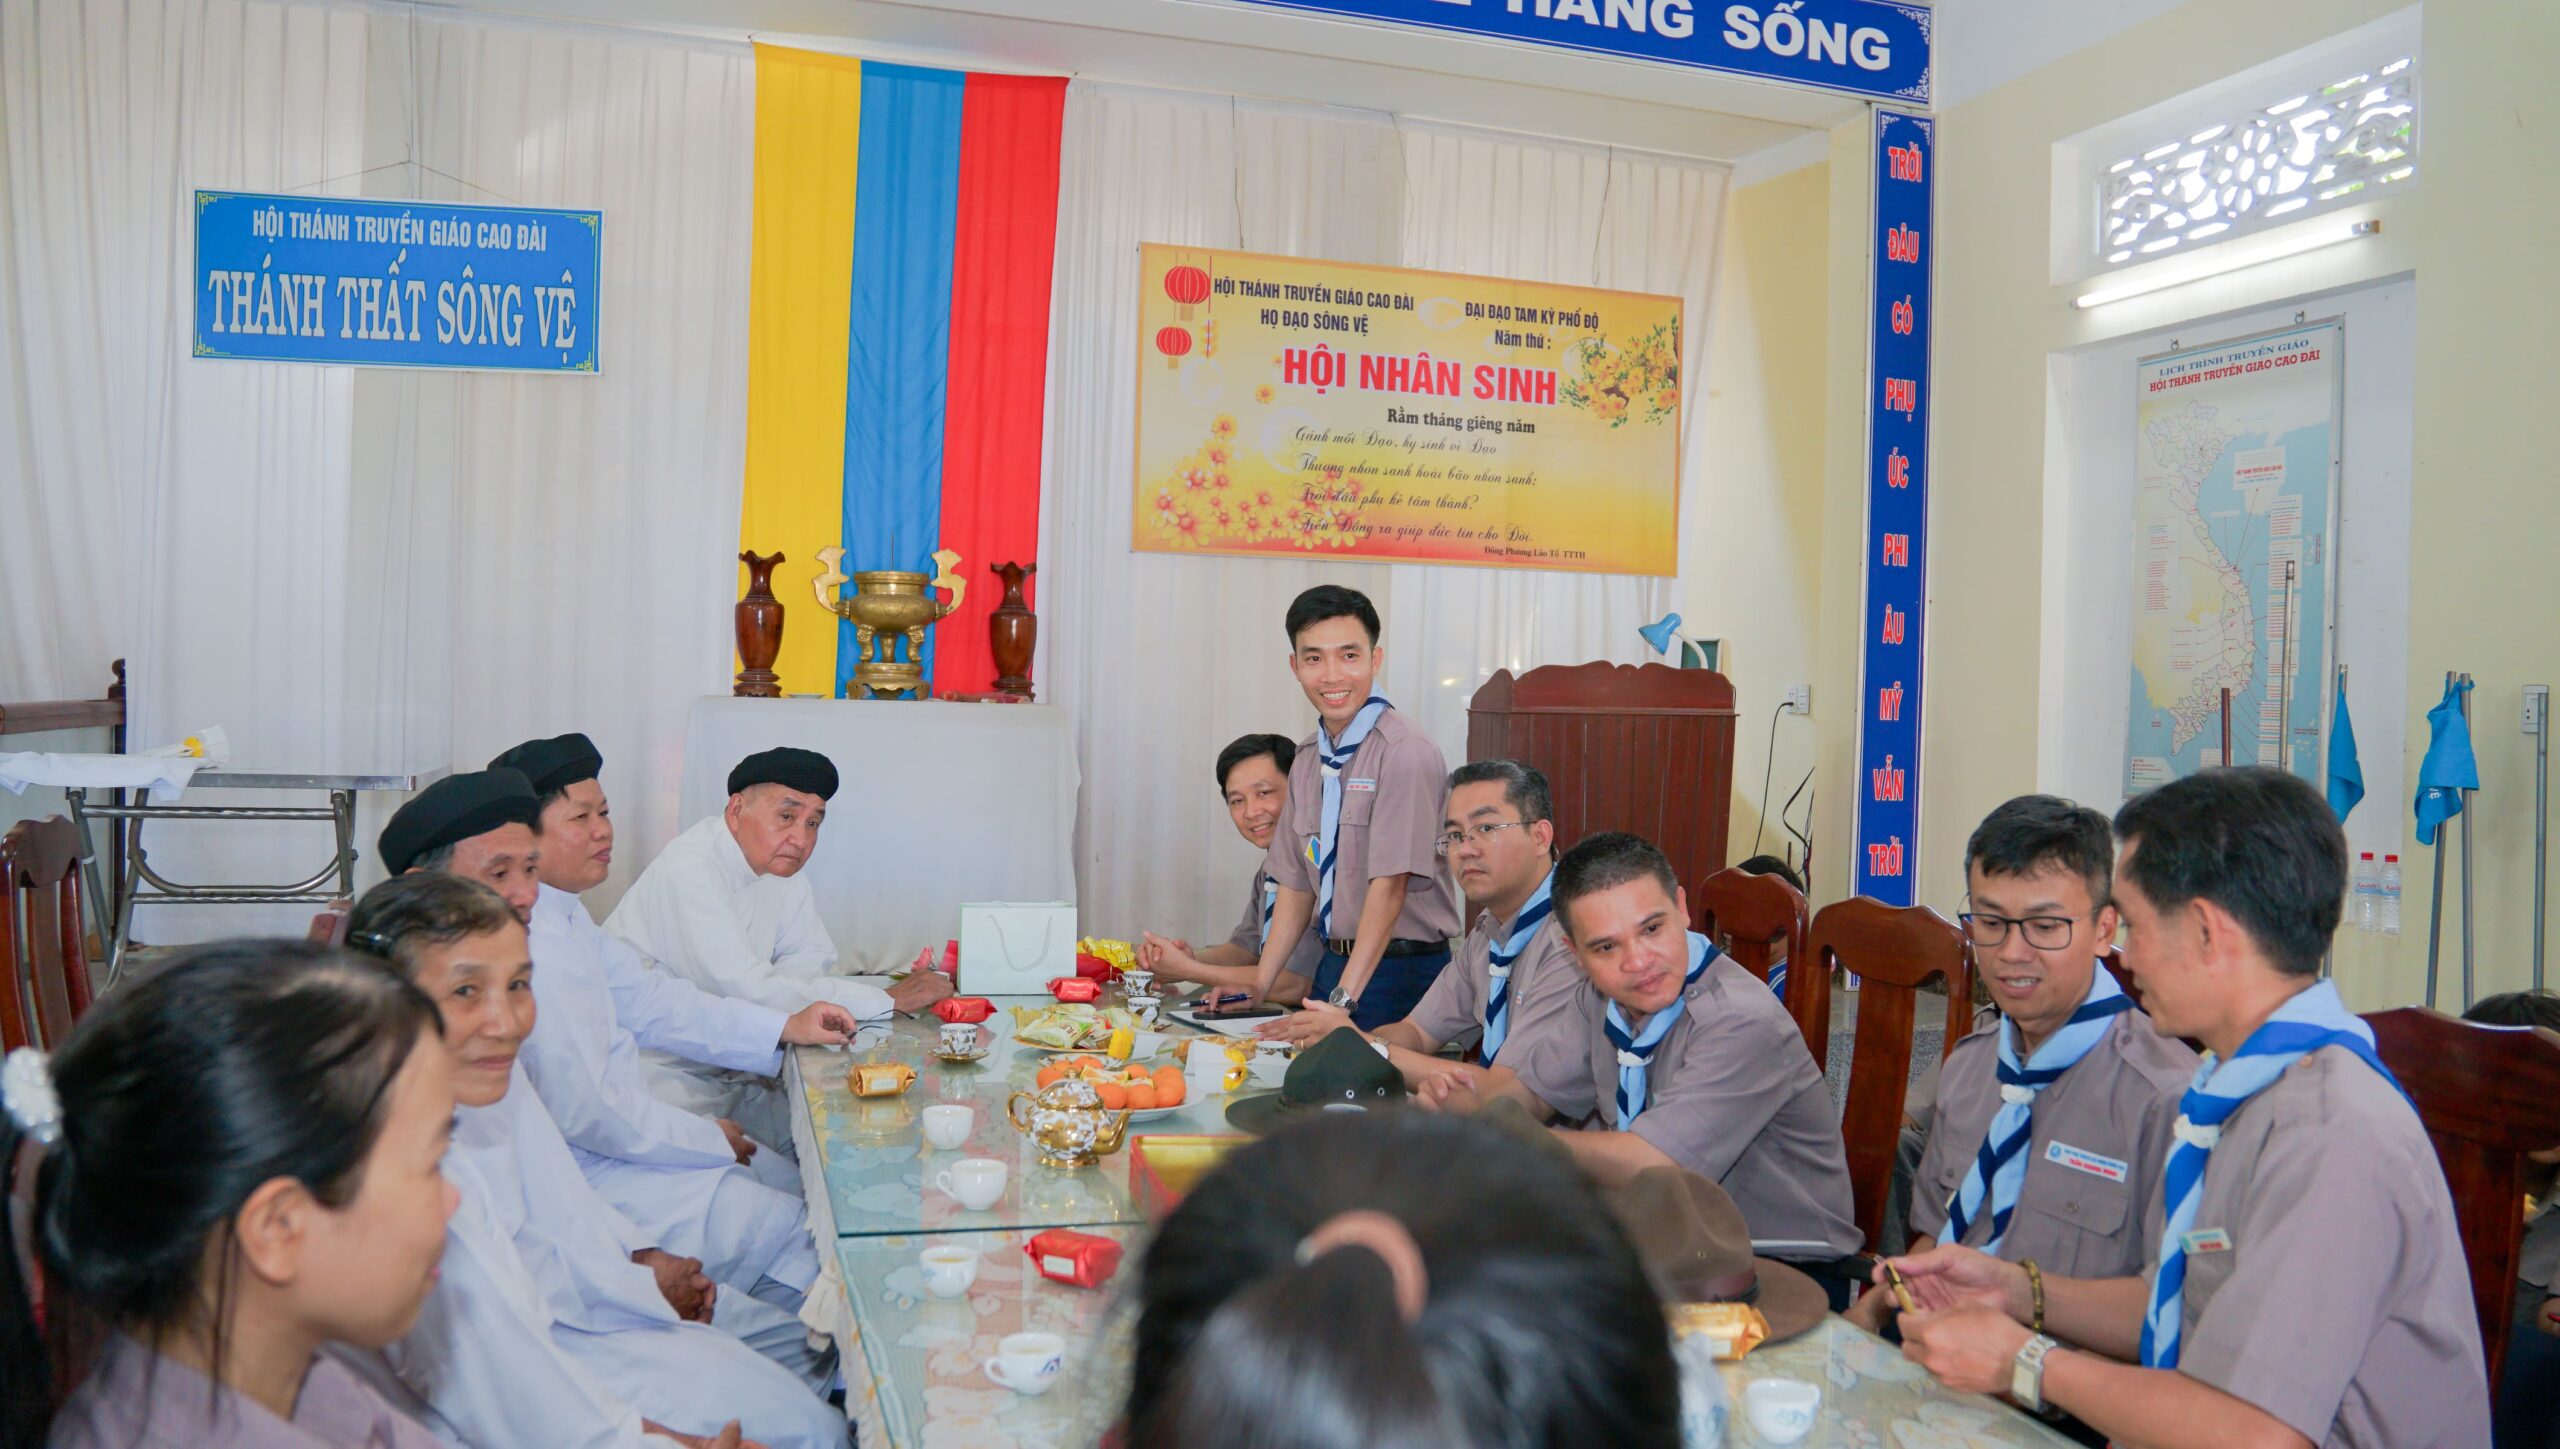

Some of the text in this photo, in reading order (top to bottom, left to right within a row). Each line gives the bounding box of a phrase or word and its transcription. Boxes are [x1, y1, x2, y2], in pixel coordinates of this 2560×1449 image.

[1723, 0, 1890, 71] SỐNG
[253, 206, 547, 252] HỘI THÁNH TRUYỀN GIÁO CAO ĐÀI
[208, 248, 577, 365] THÁNH THẤT SÔNG VỆ
[1214, 276, 1235, 298] HỘI
[1239, 278, 1280, 299] THÁNH
[1335, 288, 1363, 306] GIÁO
[1367, 292, 1390, 309] CAO
[1394, 292, 1414, 311] ĐÀI
[1261, 309, 1369, 337] HỌ ĐẠO SÔNG VỆ
[1465, 302, 1599, 333] ĐẠI ĐẠO TAM KỲ PHỔ ĐỘ
[1495, 329, 1522, 347] Năm
[1526, 331, 1545, 349] thứ
[1284, 343, 1557, 405] HỘI NHÂN SINH
[2275, 352, 2298, 368] CAO
[1387, 406, 1536, 434] Rằm tháng giêng năm
[1402, 433, 1417, 454] hy
[1420, 435, 1447, 451] sinh
[1470, 437, 1497, 455] Đạo
[1383, 462, 1413, 477] sanh
[1407, 495, 1431, 507] tâm
[1436, 494, 1479, 510] thành?
[1869, 142, 1922, 876] TRỜI ĐÂU CÓ PHỤ ÚC PHI ÂU MỸ VẪN TRỜI
[1379, 525, 1392, 534] ra
[1397, 524, 1423, 543] giúp
[1456, 526, 1473, 539] tin
[1478, 525, 1498, 540] cho
